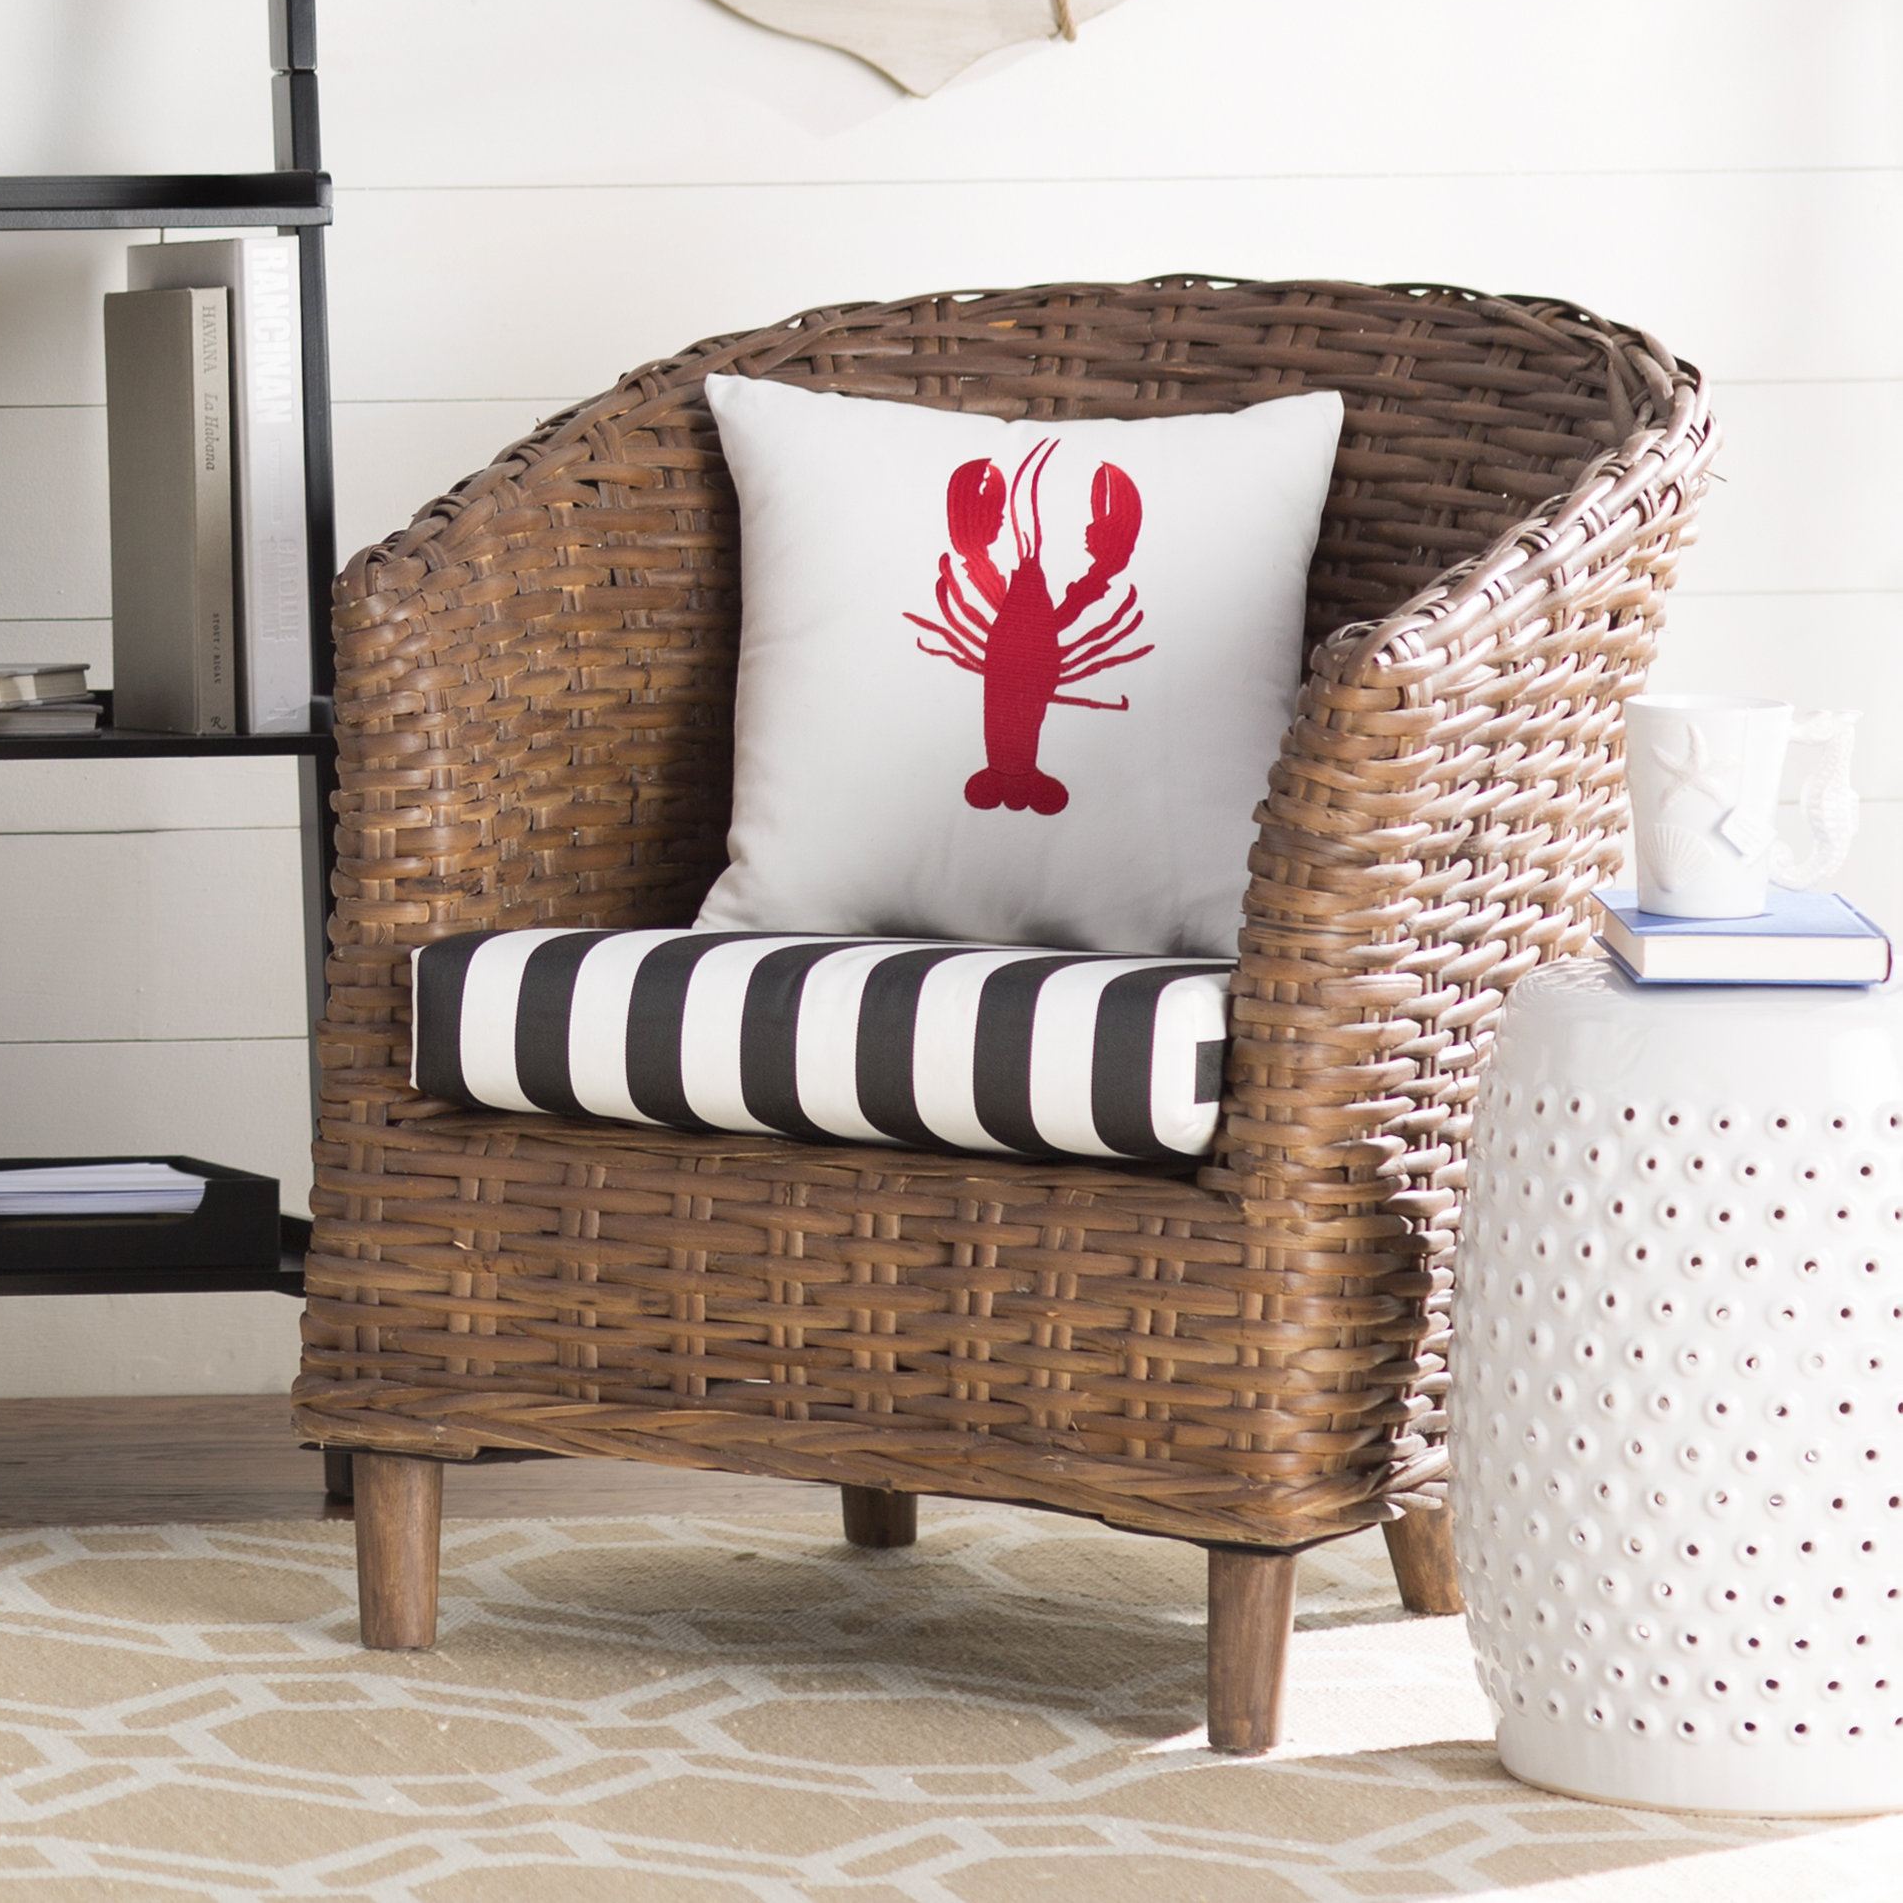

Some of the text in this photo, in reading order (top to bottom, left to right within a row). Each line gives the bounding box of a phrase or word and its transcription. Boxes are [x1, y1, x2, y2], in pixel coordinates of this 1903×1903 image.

[202, 305, 219, 472] HAVANA La Habana
[251, 246, 293, 424] RANCINAN
